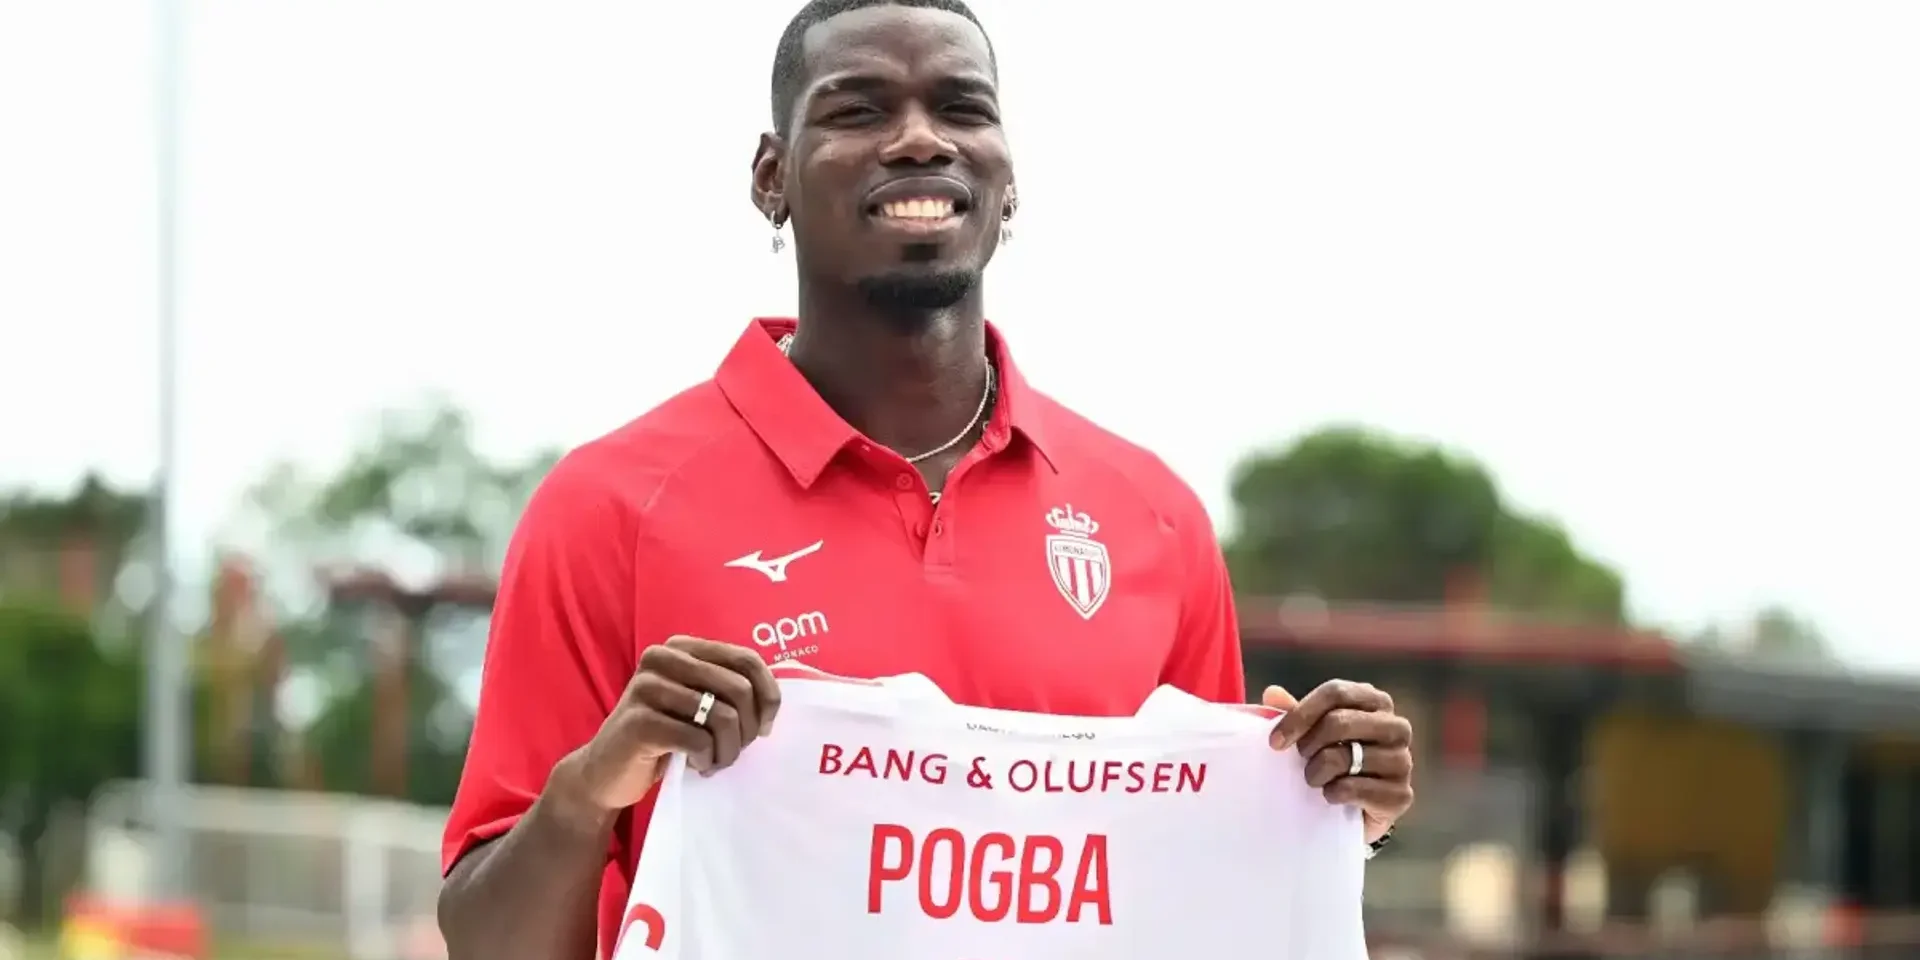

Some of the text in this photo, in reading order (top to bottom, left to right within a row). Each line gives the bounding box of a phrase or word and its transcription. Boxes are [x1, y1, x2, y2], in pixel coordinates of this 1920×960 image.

[752, 610, 829, 650] apm
[774, 645, 818, 661] MONACO
[819, 743, 1207, 793] BANG & OLUFSEN
[867, 823, 1113, 925] POGBA
